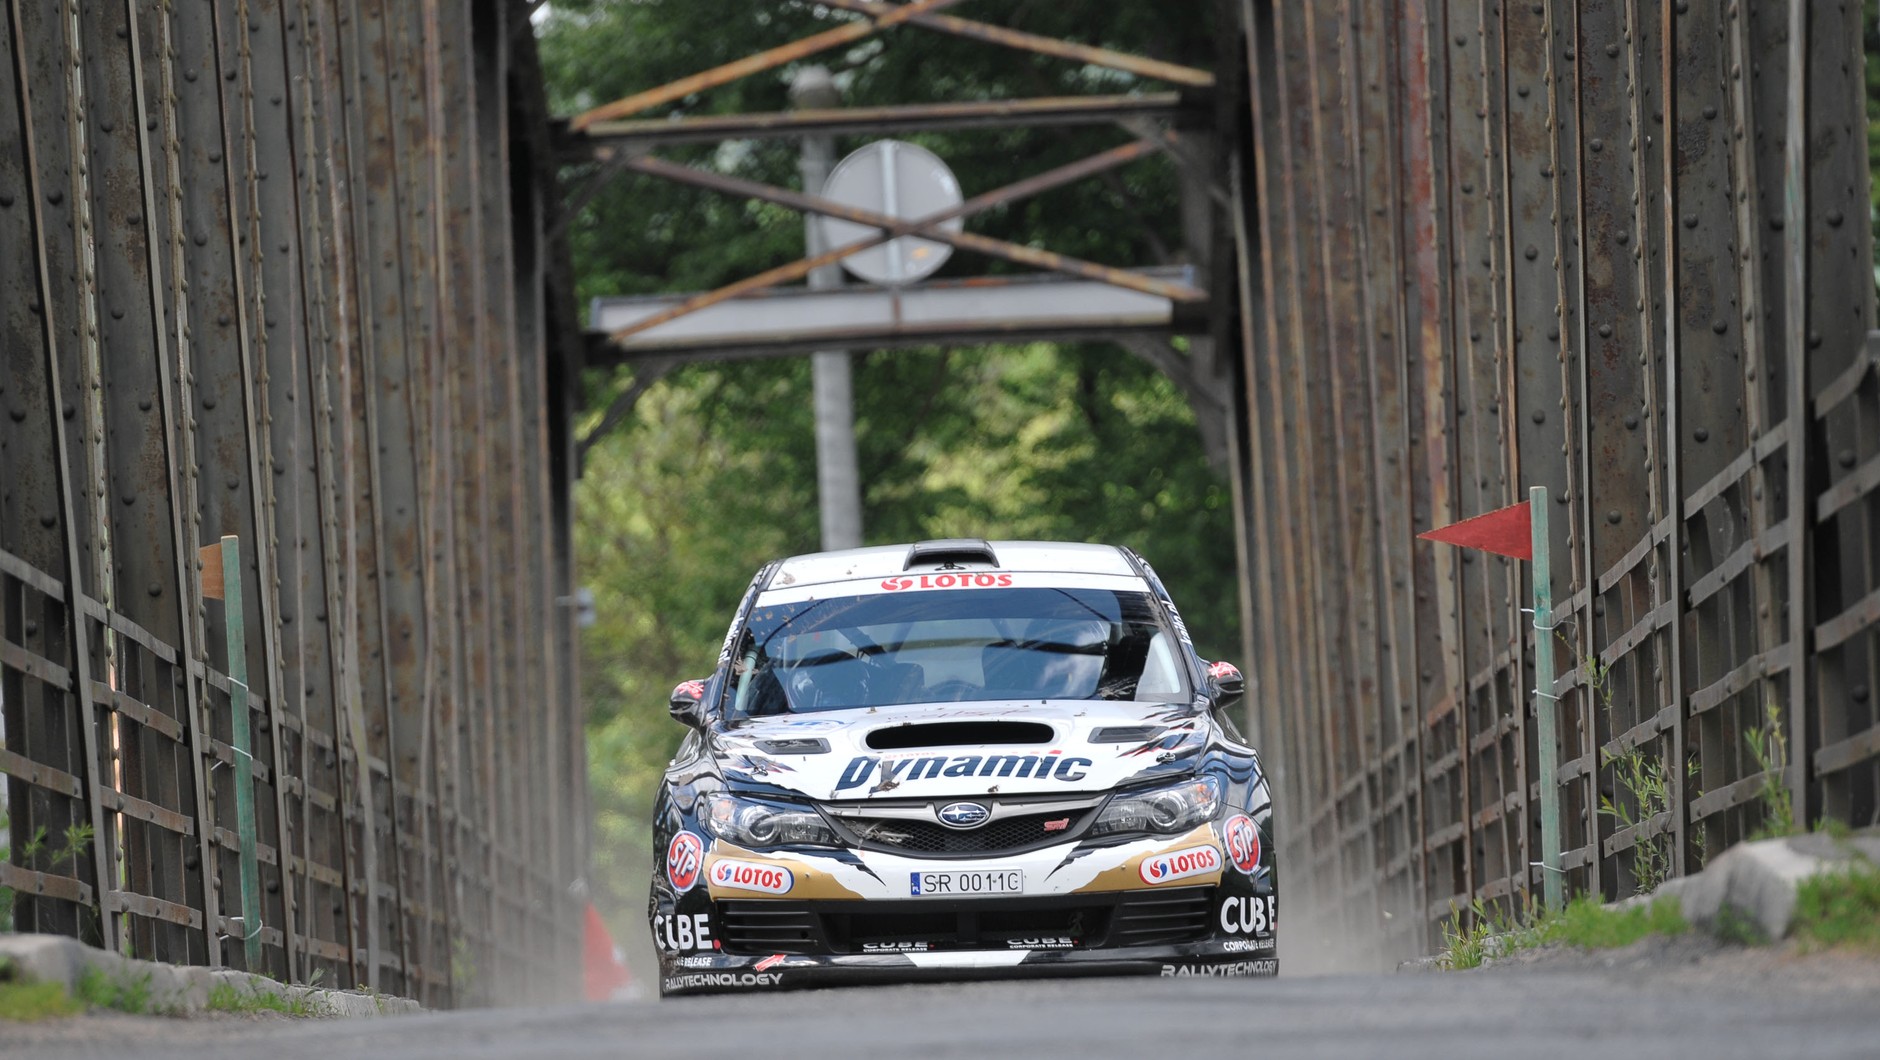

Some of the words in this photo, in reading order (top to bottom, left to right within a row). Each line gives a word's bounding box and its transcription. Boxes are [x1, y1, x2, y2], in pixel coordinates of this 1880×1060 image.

[920, 573, 1012, 588] LOTOS
[835, 750, 1092, 794] Dynamic
[1233, 821, 1255, 864] STP
[670, 839, 697, 877] STP
[1169, 850, 1215, 875] LOTOS
[733, 866, 783, 889] LOTOS
[924, 874, 952, 893] SR
[1161, 960, 1278, 977] RALLYTECHNOLOGY
[665, 973, 783, 990] RALLYTECHNOLOGY
